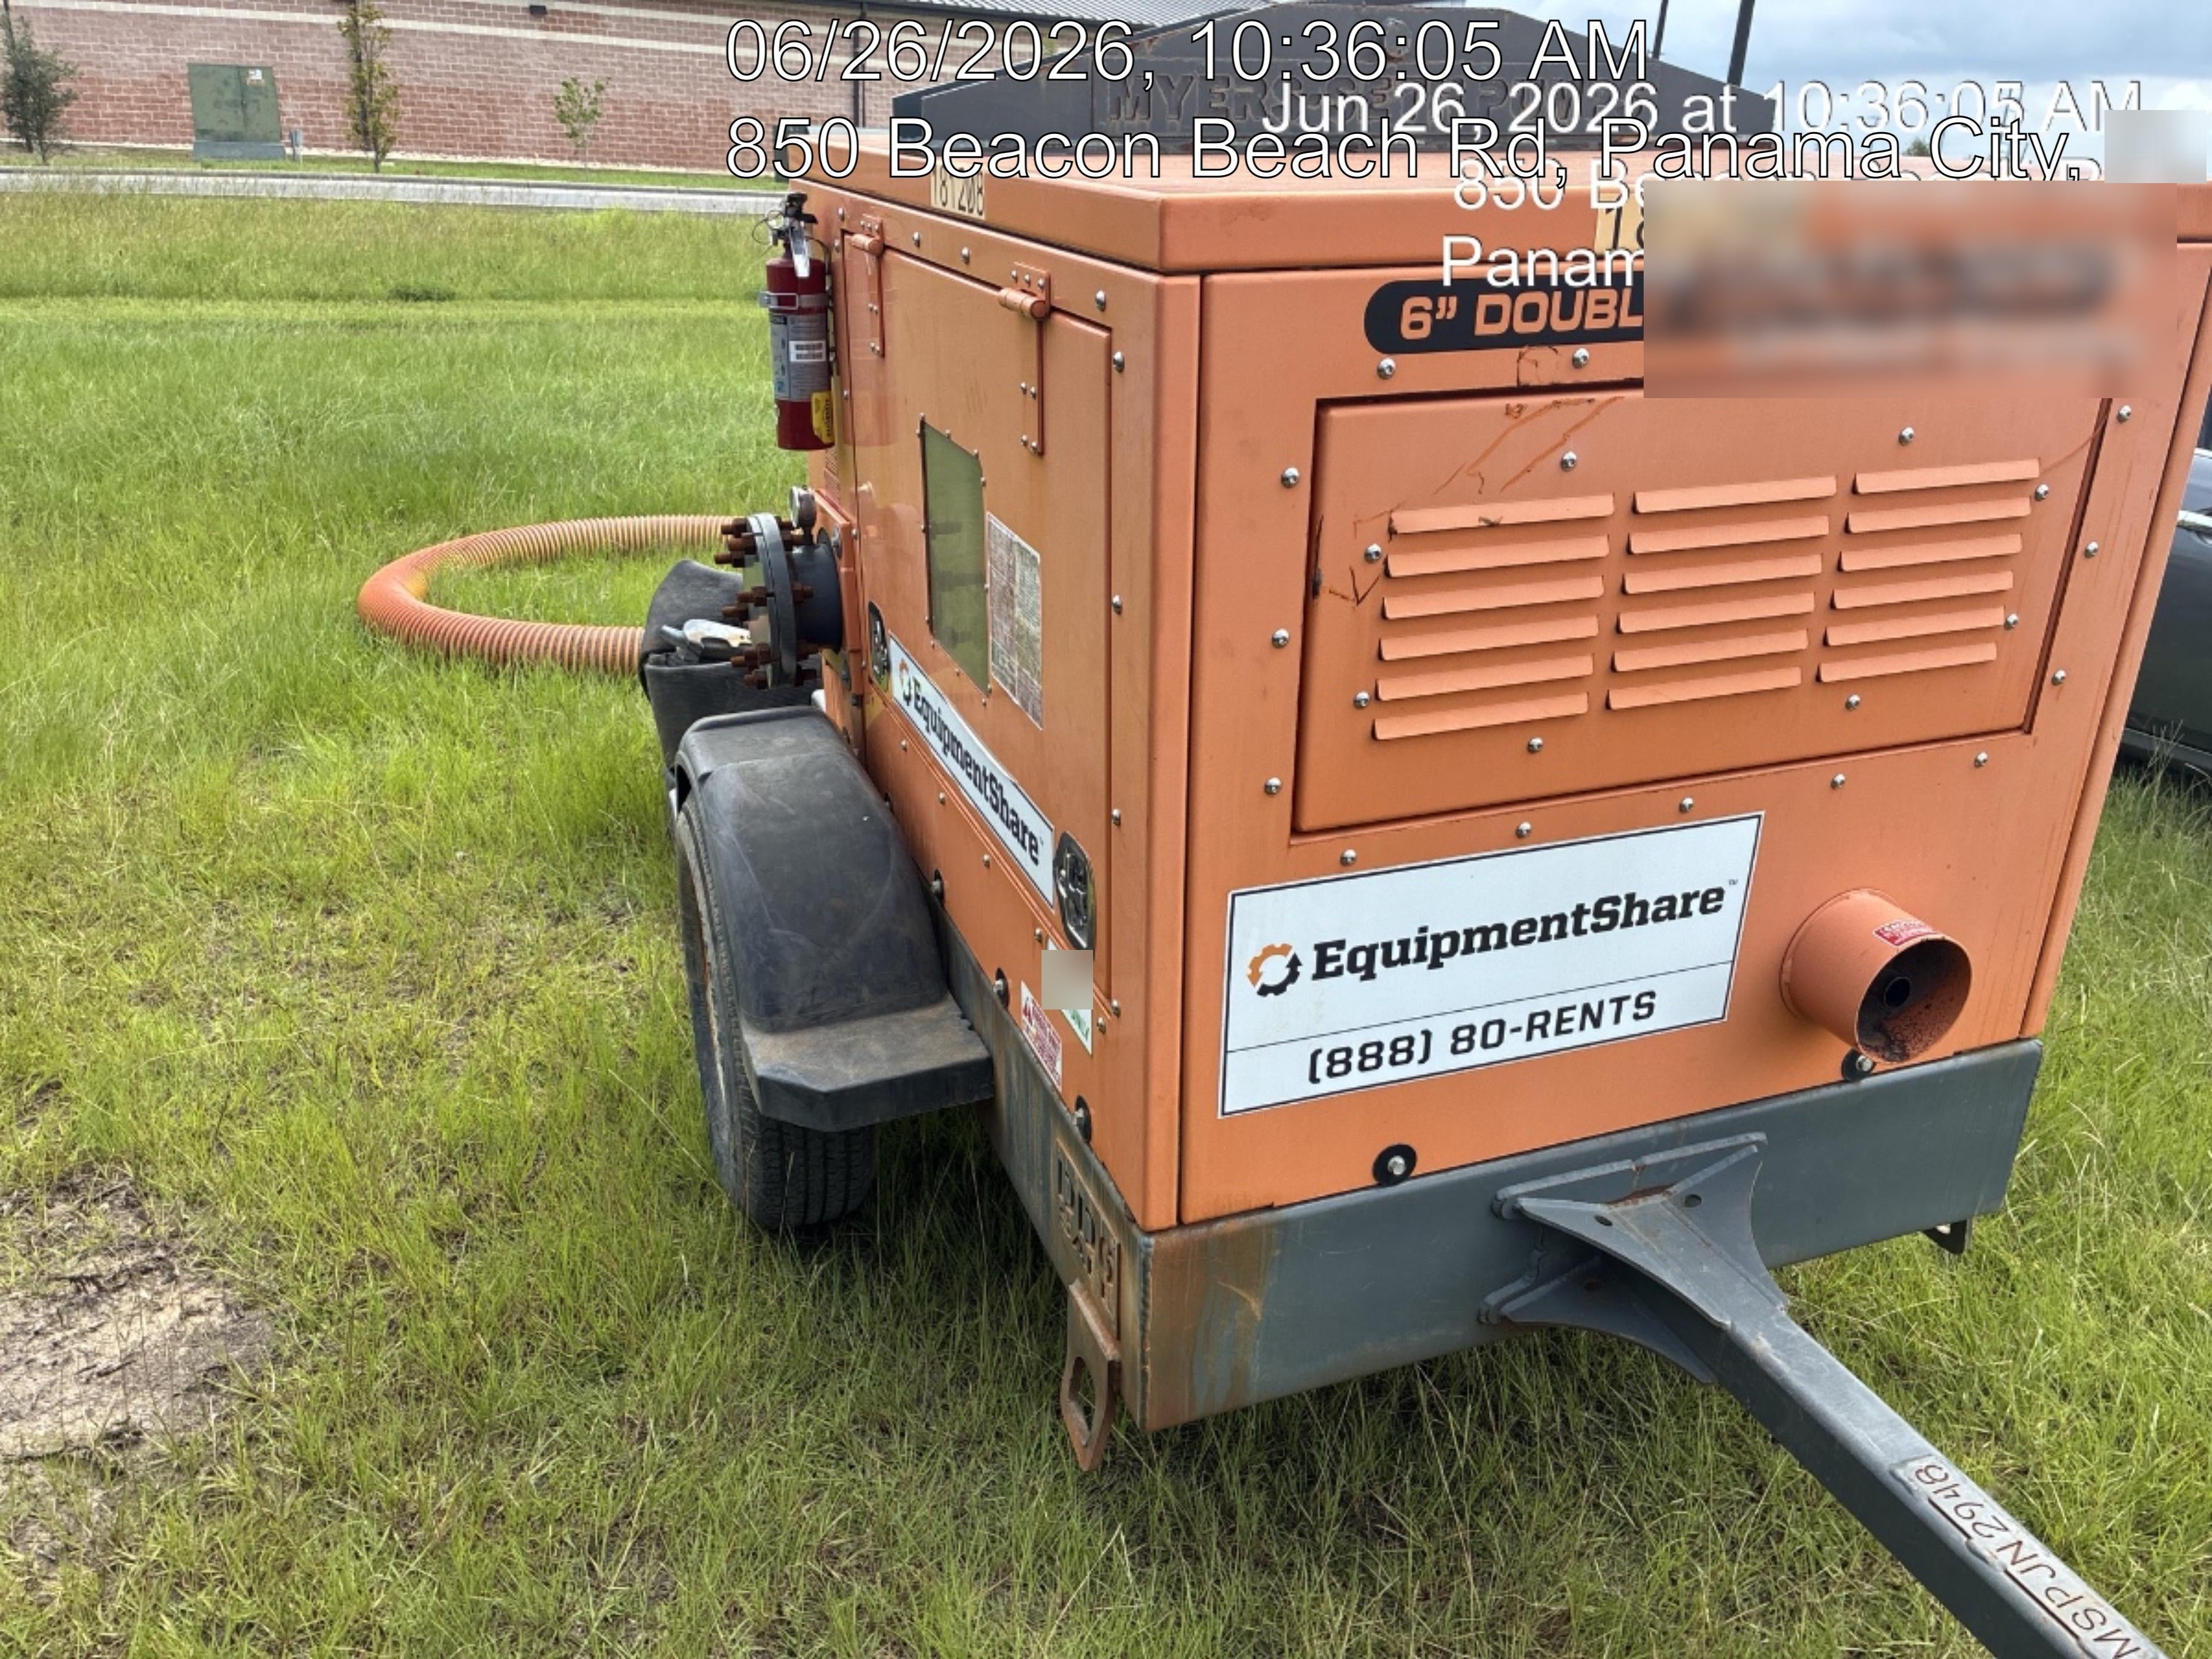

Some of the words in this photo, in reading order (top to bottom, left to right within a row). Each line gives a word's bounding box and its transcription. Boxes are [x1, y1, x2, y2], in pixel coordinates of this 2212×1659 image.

[1475, 287, 1644, 337] DOUBL
[911, 677, 1040, 867] EquipmentShare
[1311, 885, 1727, 982] EquipmentShare
[1308, 1028, 1432, 1084] (888)
[1449, 990, 1658, 1056] 80-RENTS
